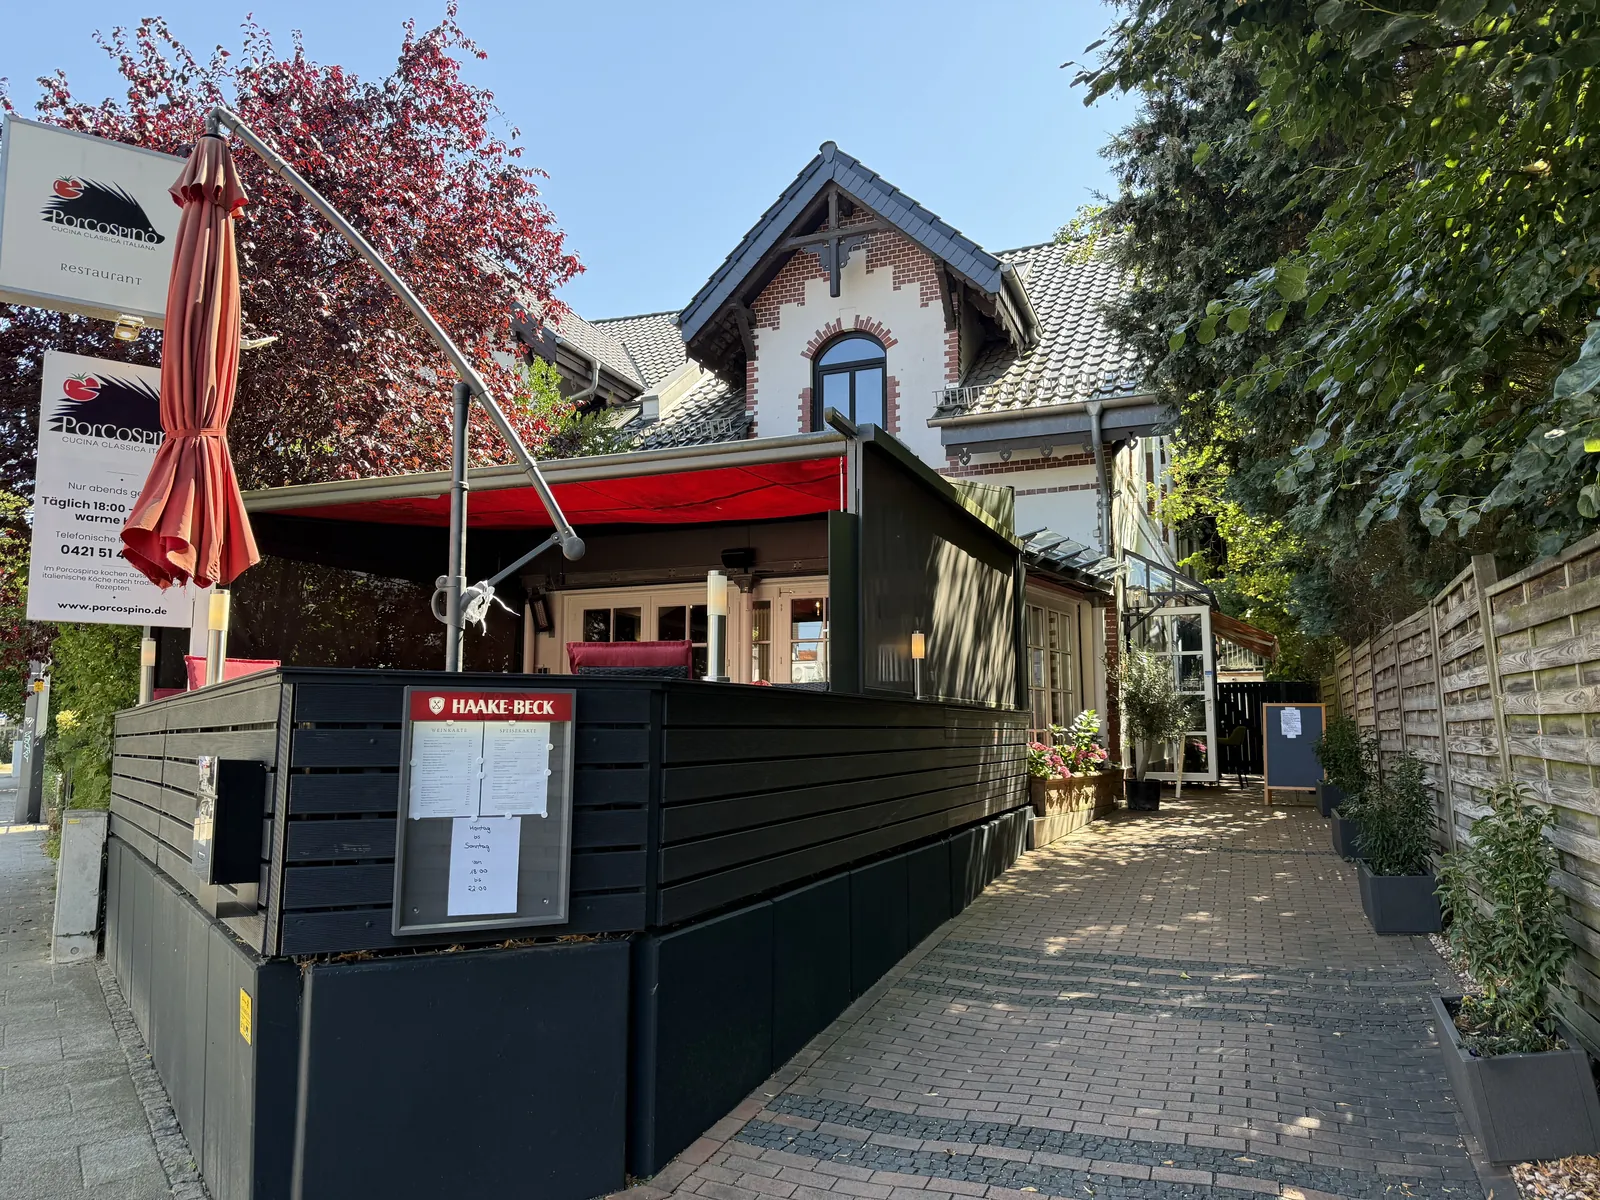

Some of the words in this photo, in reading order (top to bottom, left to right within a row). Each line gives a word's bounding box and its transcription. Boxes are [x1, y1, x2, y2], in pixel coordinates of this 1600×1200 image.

[51, 225, 82, 236] CUCINA
[84, 232, 122, 244] CLASSICA
[123, 240, 156, 251] ITALIANA
[62, 436, 99, 447] CUCINA
[101, 441, 146, 453] CLASSICA
[68, 481, 86, 490] Nur
[89, 484, 128, 496] abends
[42, 496, 91, 509] Täglich
[93, 501, 126, 513] 18:00
[75, 513, 121, 525] warme
[55, 530, 116, 543] Telefonische
[60, 544, 94, 557] 0421
[98, 548, 112, 558] 51
[55, 566, 99, 576] Porcospino
[100, 569, 128, 577] kochen
[42, 572, 87, 581] italienische
[88, 574, 112, 583] Köche
[113, 577, 132, 585] nach
[95, 583, 132, 592] Rezepten.
[57, 602, 167, 615] www.porcospino.de
[452, 698, 555, 715] HAAKE-BECK
